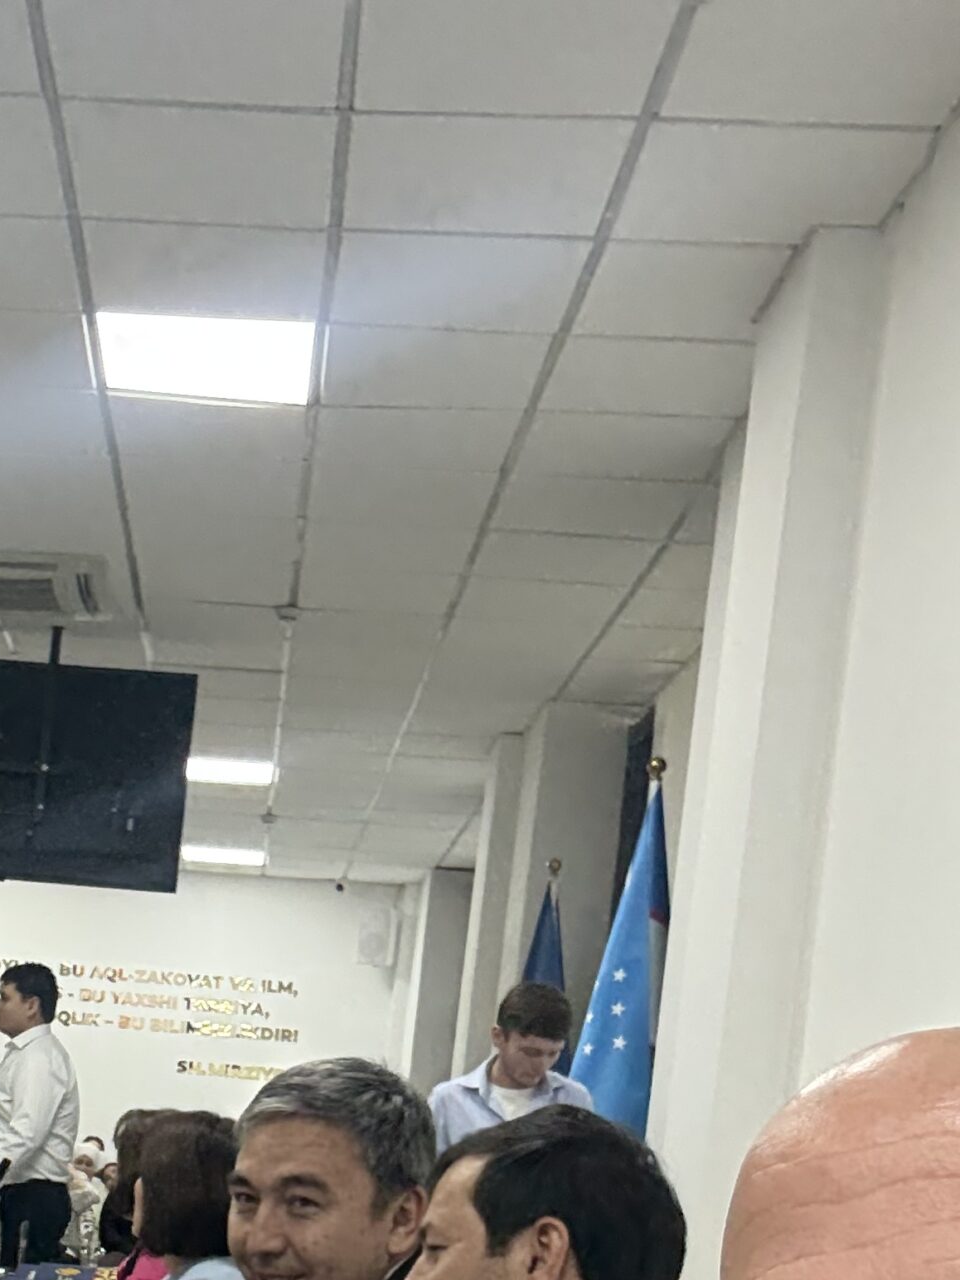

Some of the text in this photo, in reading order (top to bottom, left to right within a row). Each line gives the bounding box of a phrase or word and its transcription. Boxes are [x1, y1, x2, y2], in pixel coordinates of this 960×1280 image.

[59, 963, 85, 977] BU
[261, 979, 299, 998] ILM,
[79, 988, 106, 1003] BU
[118, 1014, 145, 1030] BU
